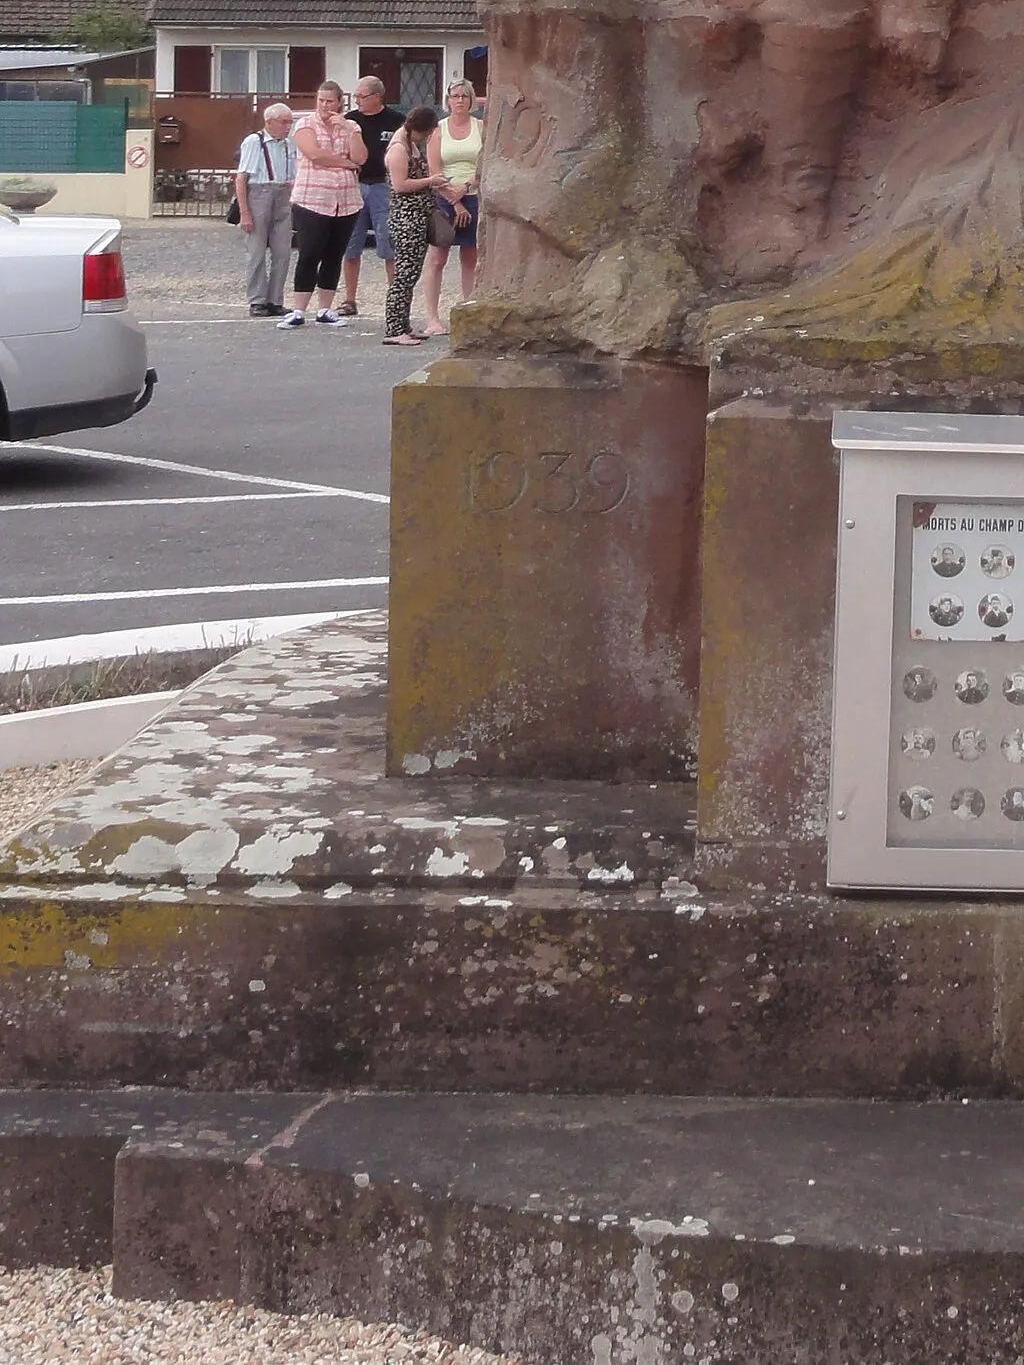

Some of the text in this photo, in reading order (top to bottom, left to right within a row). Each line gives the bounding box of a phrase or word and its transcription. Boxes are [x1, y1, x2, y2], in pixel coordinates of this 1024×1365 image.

[464, 450, 631, 514] 1939
[922, 518, 957, 531] MORTS
[960, 518, 974, 531] AU
[978, 519, 1014, 532] CHAMP
